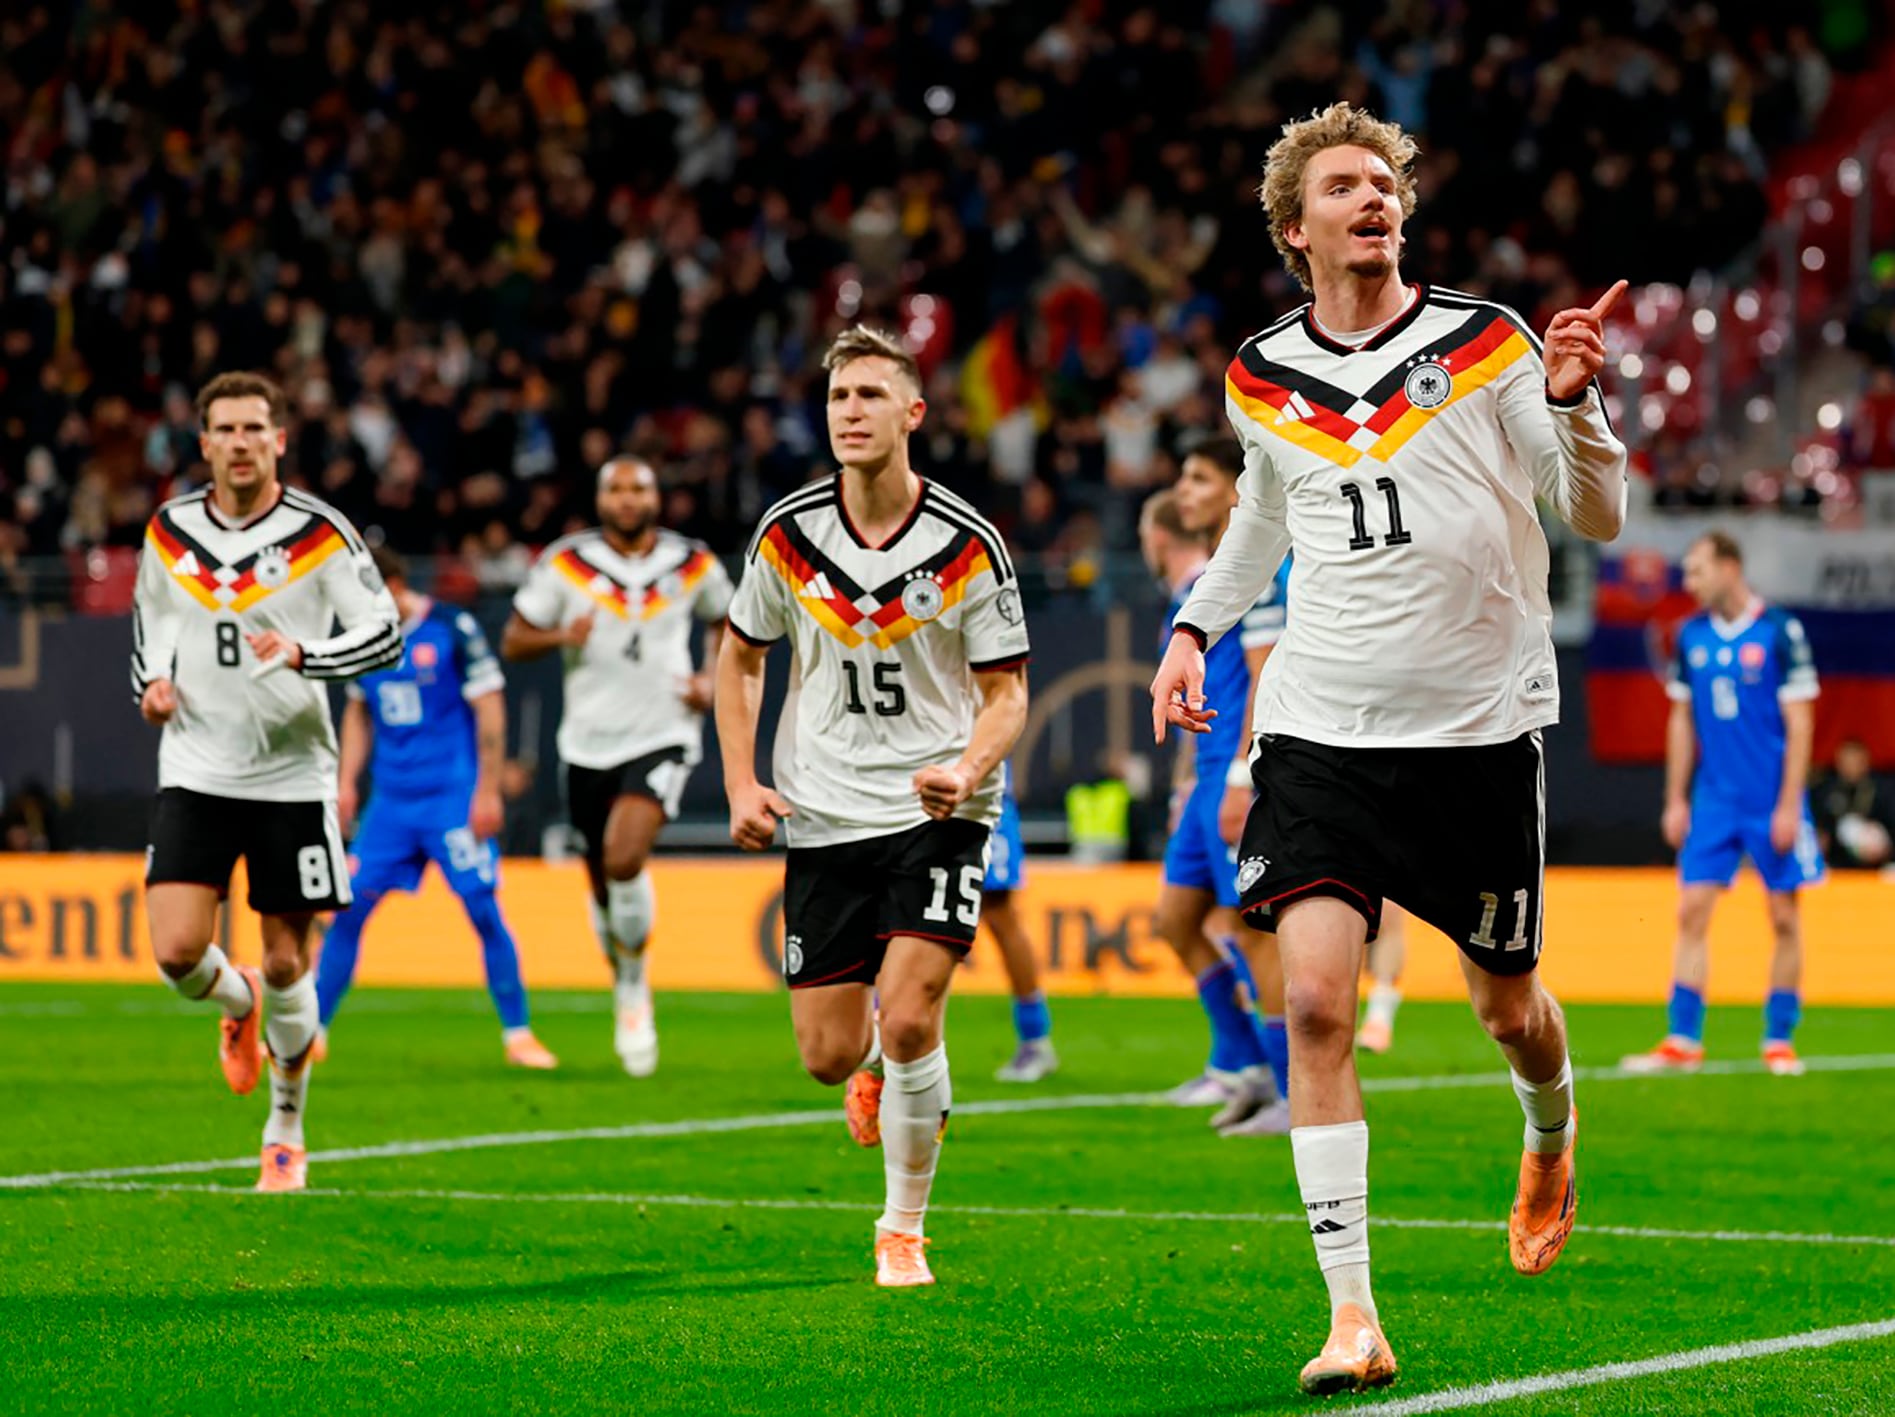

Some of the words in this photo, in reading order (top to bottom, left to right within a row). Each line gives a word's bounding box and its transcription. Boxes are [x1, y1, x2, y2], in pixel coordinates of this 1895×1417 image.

[1340, 476, 1412, 551] 11
[216, 621, 241, 667] 8
[622, 631, 641, 663] 4
[842, 660, 906, 716] 15
[298, 845, 332, 899] 8
[923, 864, 984, 927] 15
[1469, 888, 1528, 952] 11
